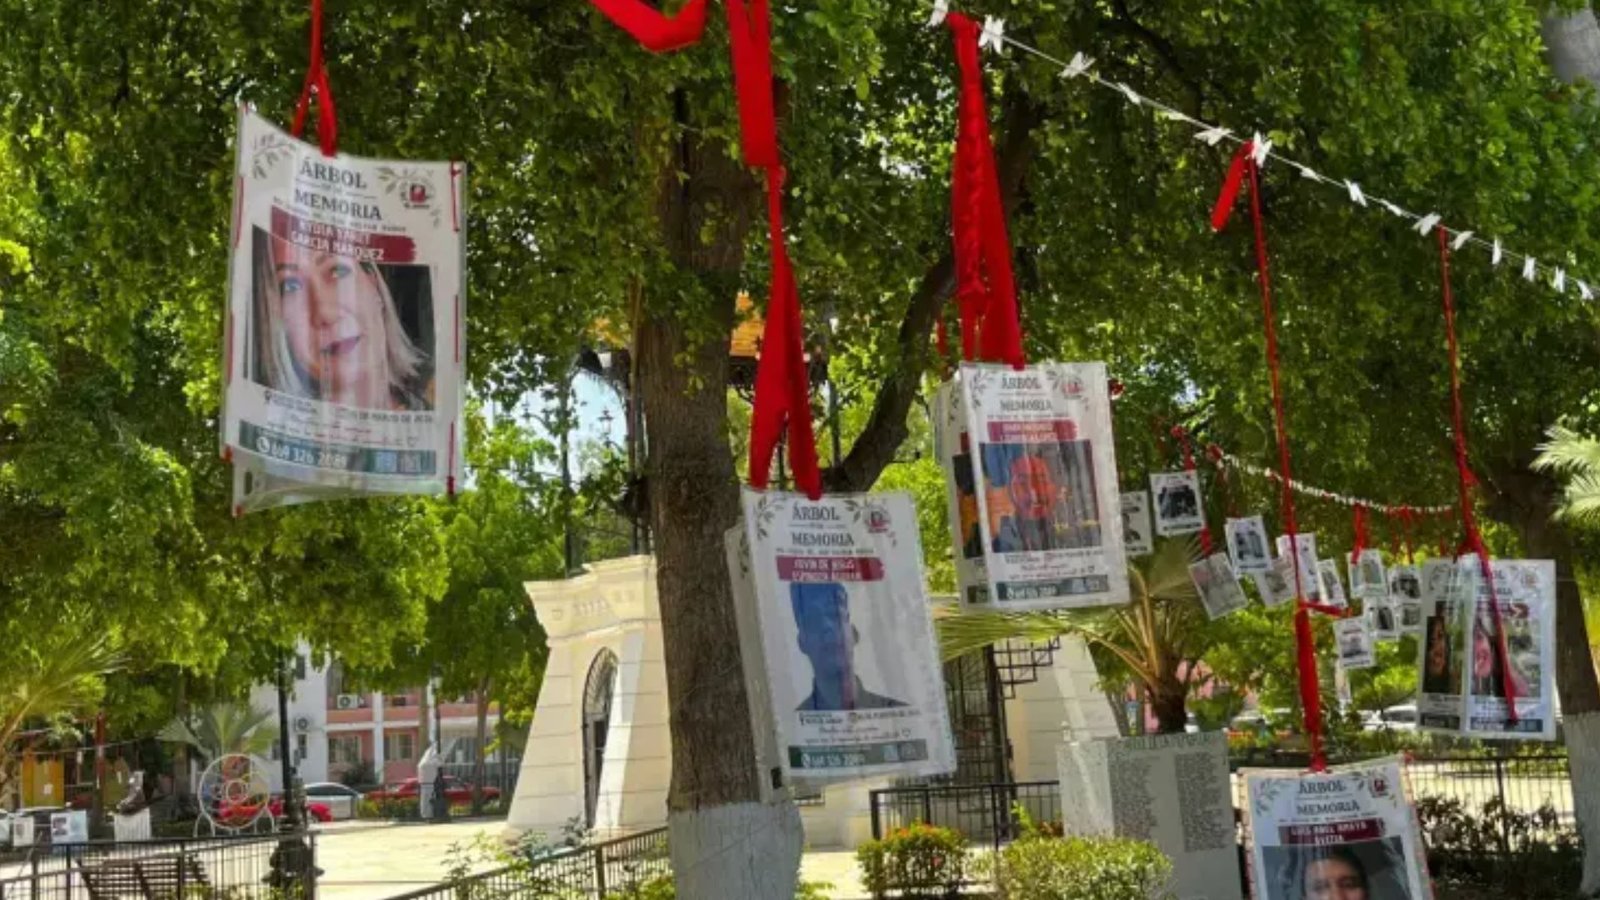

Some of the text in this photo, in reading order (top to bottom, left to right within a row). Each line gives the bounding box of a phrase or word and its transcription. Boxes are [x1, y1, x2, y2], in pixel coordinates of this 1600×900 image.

[300, 156, 366, 189] ÁRBOL
[294, 188, 382, 221] MEMORIA
[792, 503, 840, 521] ÁRBOL
[792, 532, 855, 547] MEMORIA
[1296, 799, 1361, 816] MEMORIA
